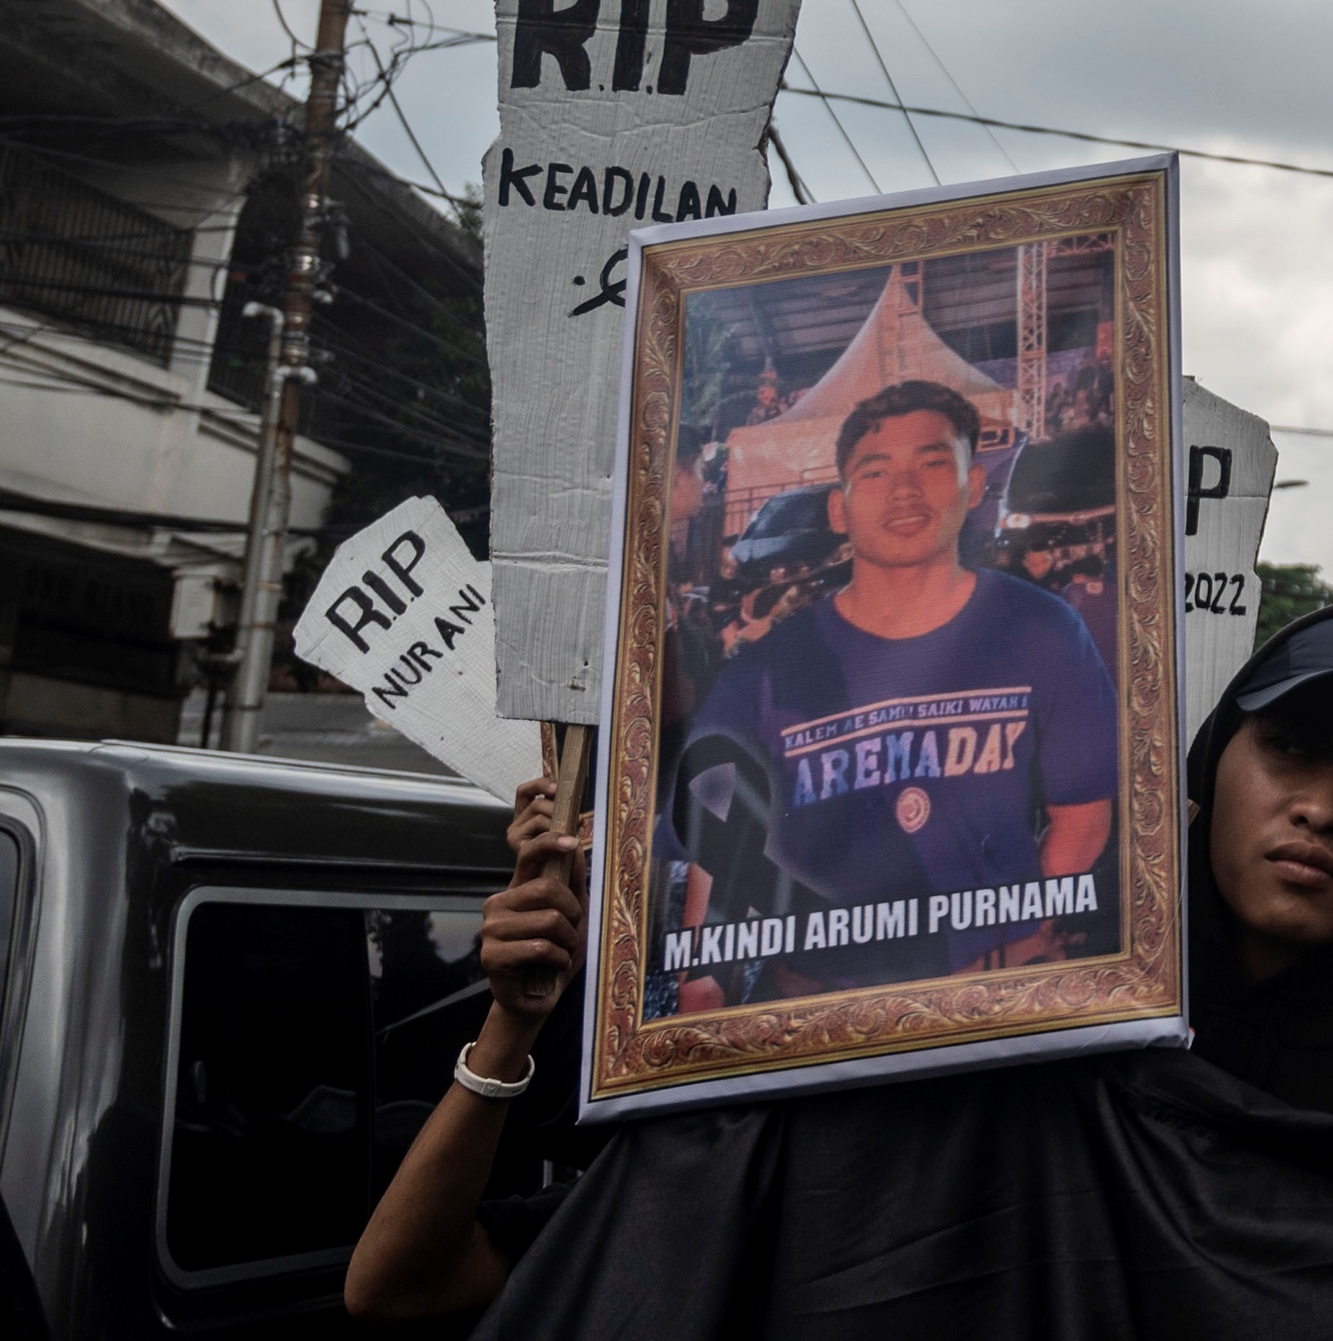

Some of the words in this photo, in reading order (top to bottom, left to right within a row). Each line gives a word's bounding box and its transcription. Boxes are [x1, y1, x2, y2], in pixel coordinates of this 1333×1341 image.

[499, 148, 737, 222] KEADILAN
[664, 917, 796, 971] M.KINDI
[804, 898, 918, 951] ARUMI
[928, 873, 1099, 934] PURNAMA
